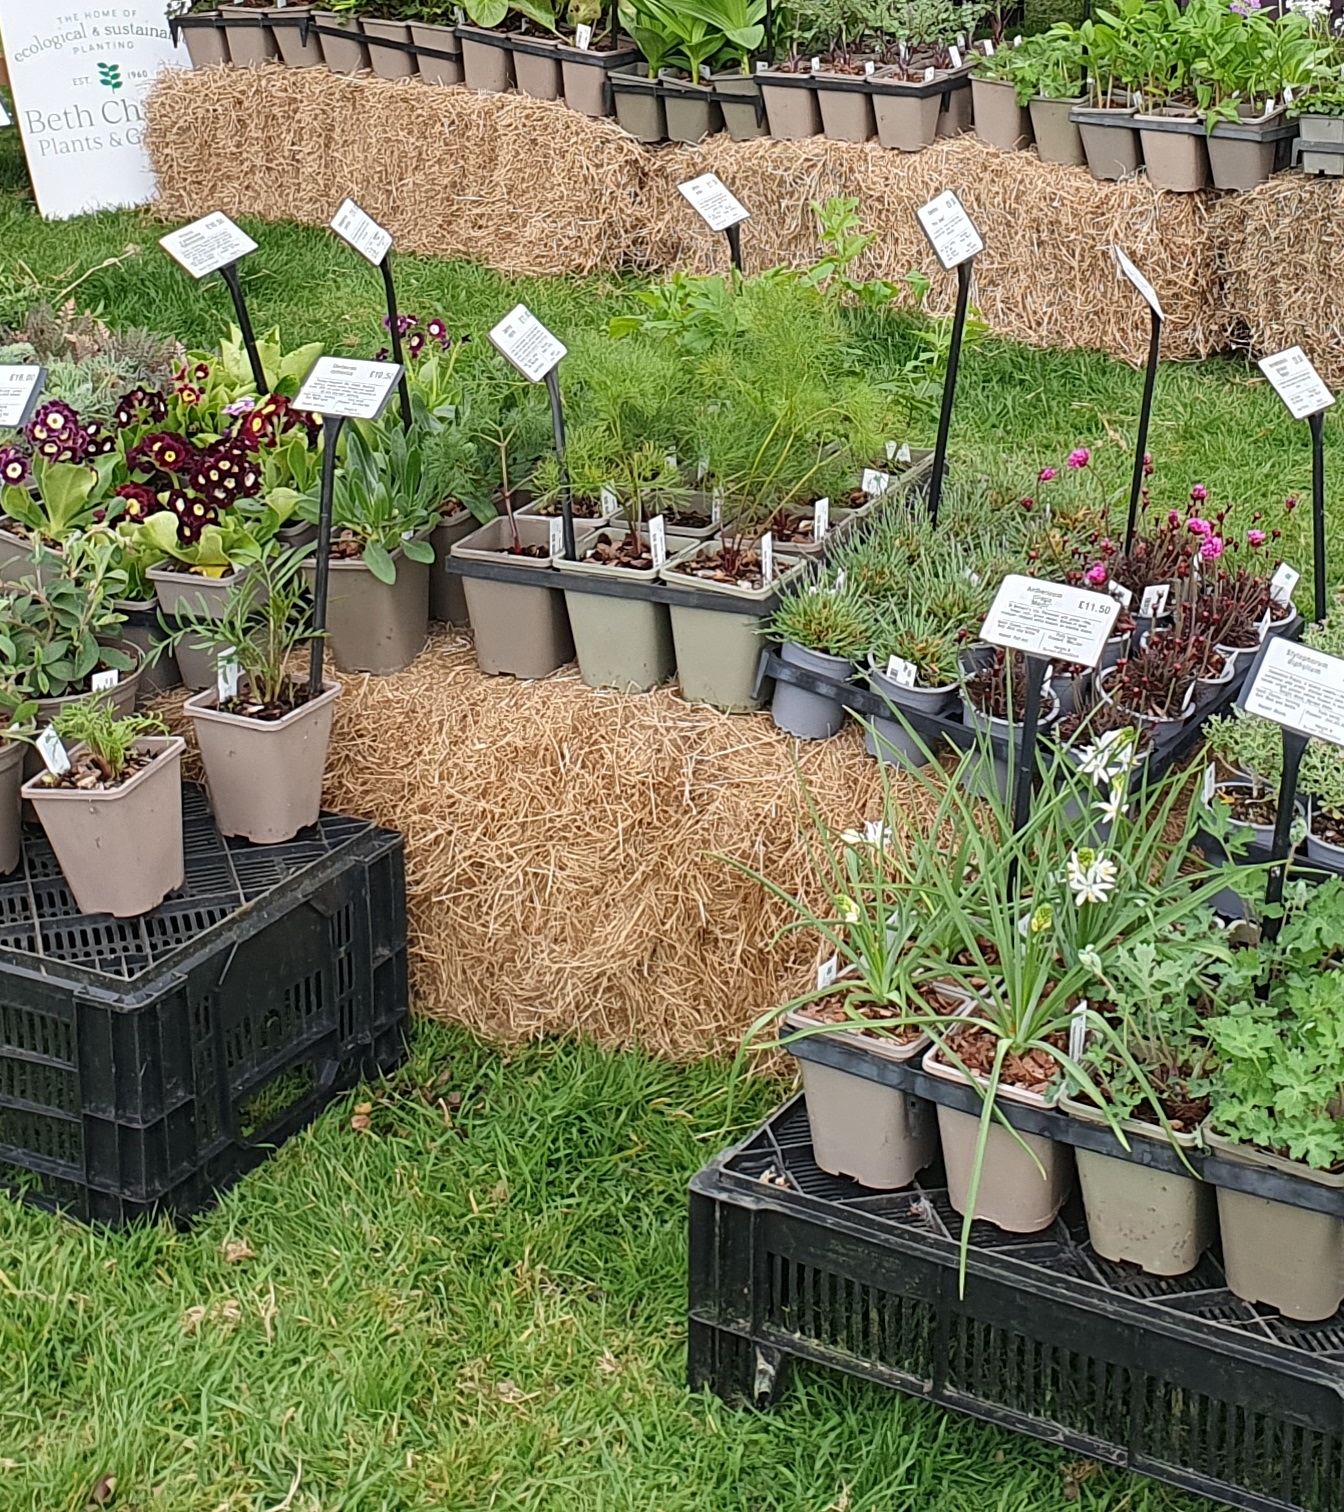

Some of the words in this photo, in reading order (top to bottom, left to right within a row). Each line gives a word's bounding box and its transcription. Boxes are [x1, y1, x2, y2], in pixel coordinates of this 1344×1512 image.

[56, 13, 80, 24] THE
[84, 9, 117, 20] HOME
[123, 9, 137, 18] OF
[14, 22, 87, 62] ecological
[92, 27, 100, 37] &
[104, 22, 186, 44] sustaina
[73, 40, 134, 54] PLANTING
[127, 70, 148, 79] 1960
[24, 104, 94, 134] Beth
[101, 98, 144, 125] Ch
[38, 135, 103, 156] Plants
[109, 132, 122, 147] &
[126, 127, 142, 146] G
[1078, 600, 1112, 615] £11.50
